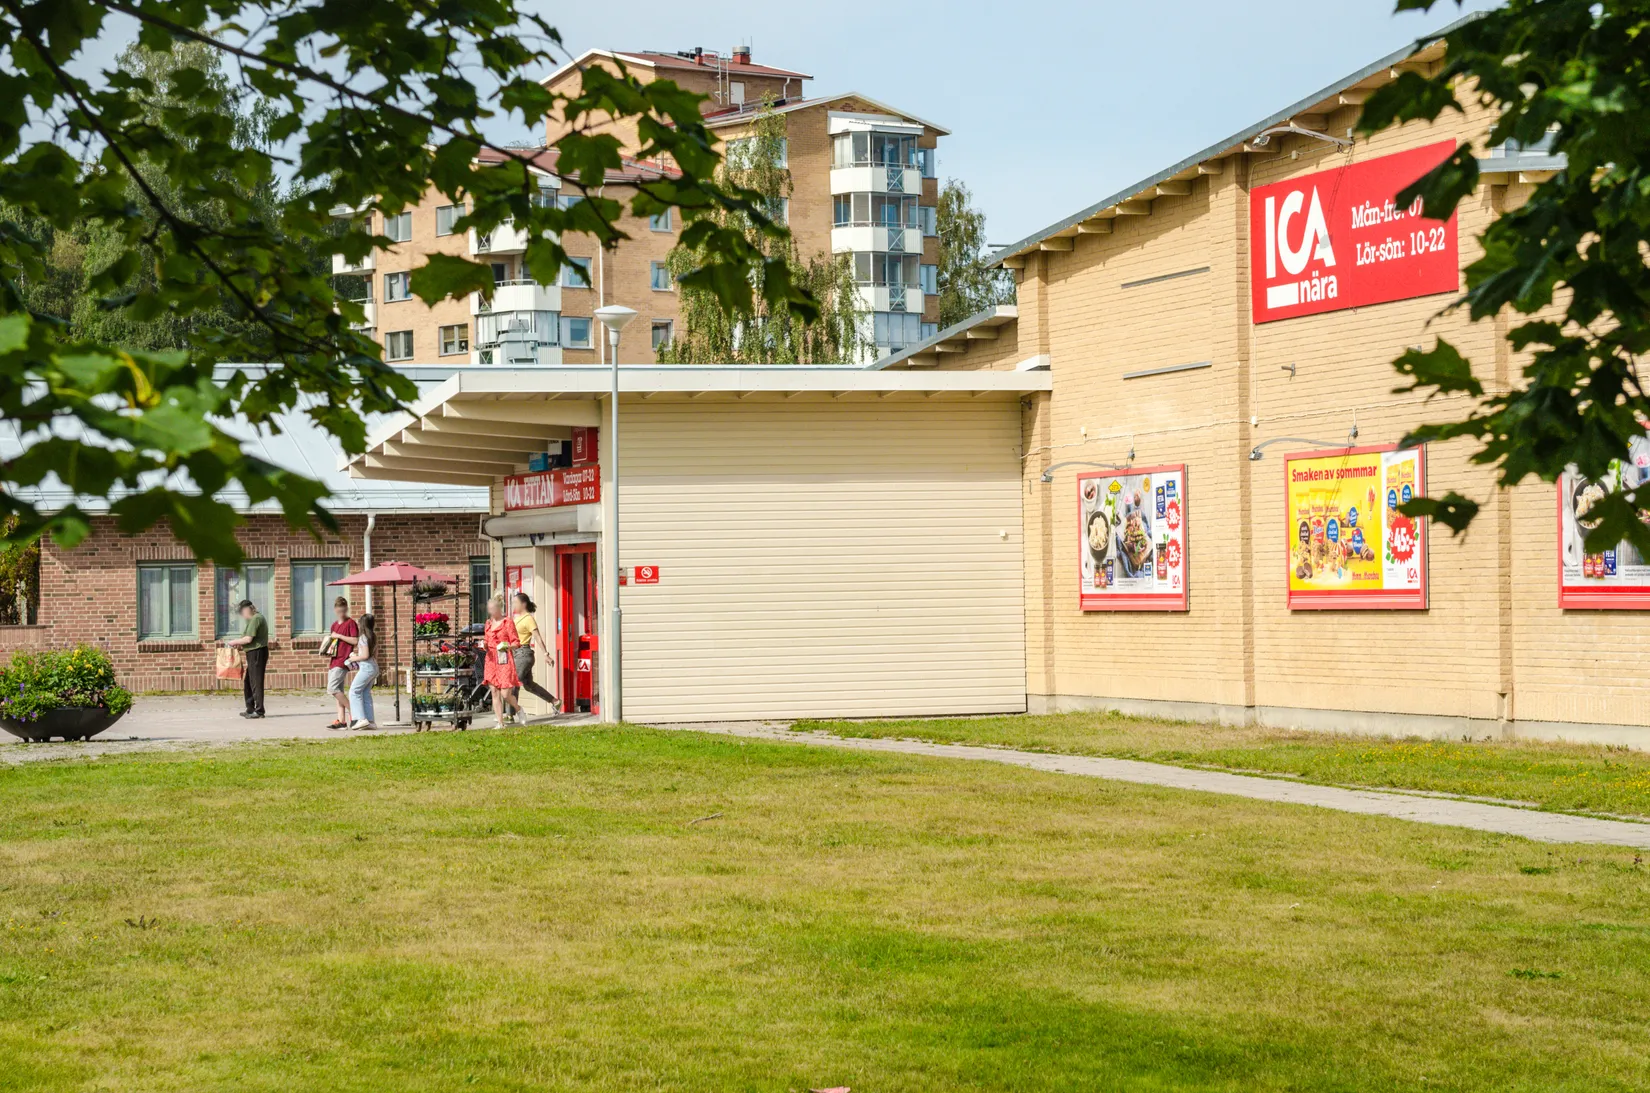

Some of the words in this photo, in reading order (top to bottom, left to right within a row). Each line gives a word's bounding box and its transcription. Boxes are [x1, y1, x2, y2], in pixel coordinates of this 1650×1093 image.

[1265, 185, 1336, 279] ICA
[1356, 237, 1405, 266] Lör-sön:
[1410, 226, 1446, 256] 10-22
[1300, 270, 1338, 304] nära
[507, 478, 521, 508] ICA
[523, 473, 554, 506] ETTAN
[1292, 467, 1323, 483] Smaken
[1324, 469, 1335, 480] av
[583, 486, 595, 501] 10-22
[1407, 567, 1419, 580] ICA
